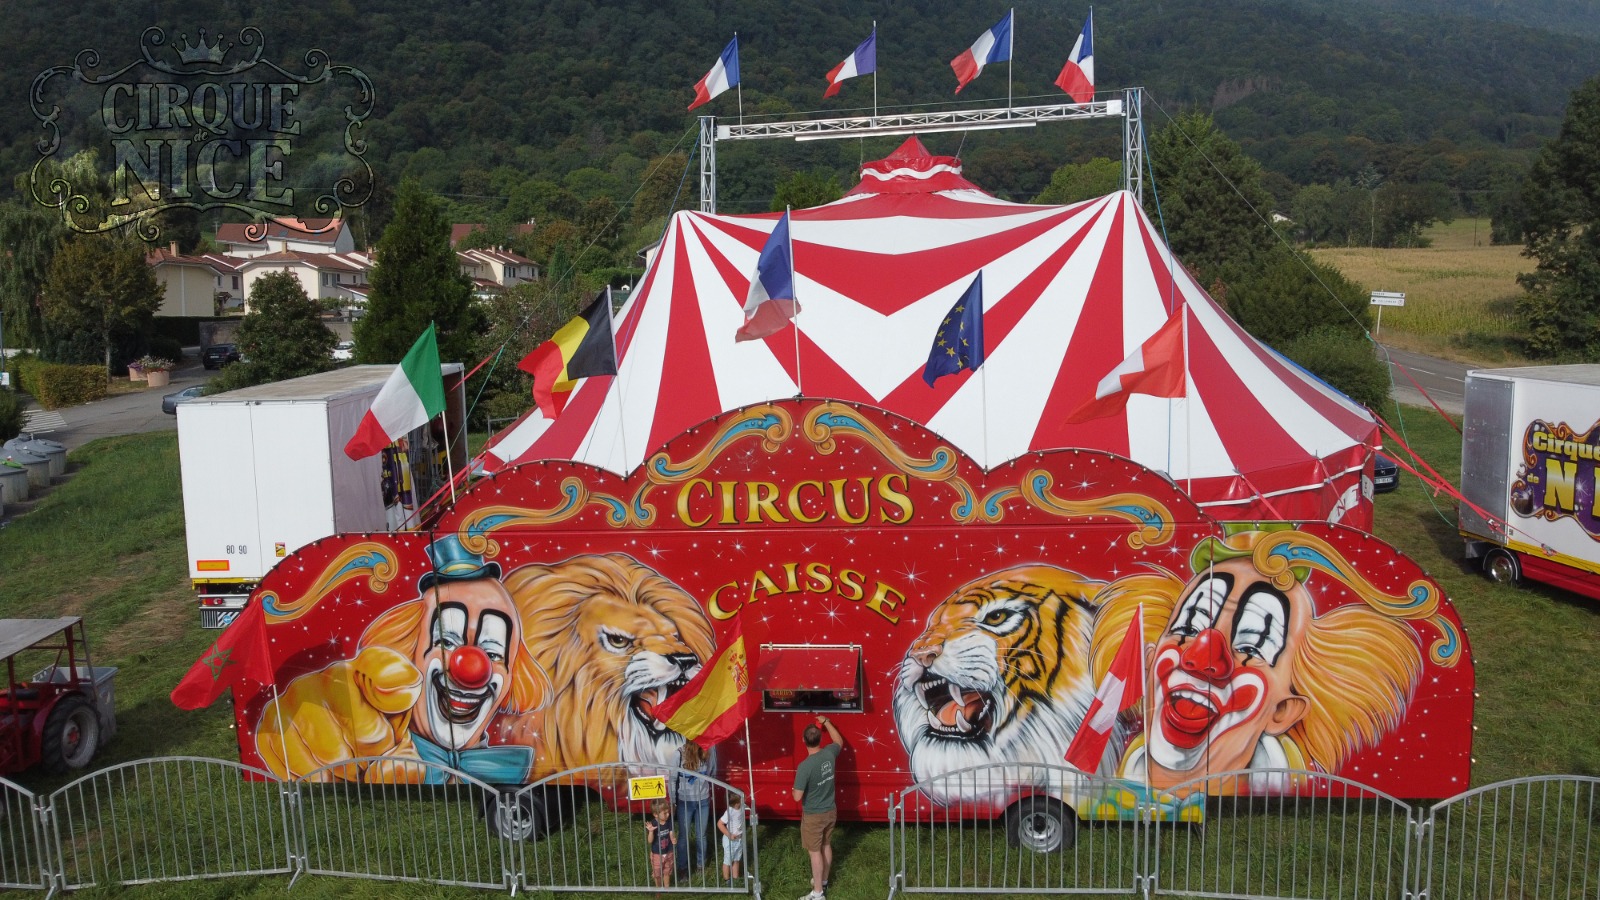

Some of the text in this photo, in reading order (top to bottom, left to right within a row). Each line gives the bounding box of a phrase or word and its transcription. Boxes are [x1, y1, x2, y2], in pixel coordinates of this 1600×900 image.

[1527, 473, 1540, 484] de
[677, 474, 915, 527] CIRCUS
[226, 545, 248, 555] 80 90
[707, 562, 906, 625] CAISSE
